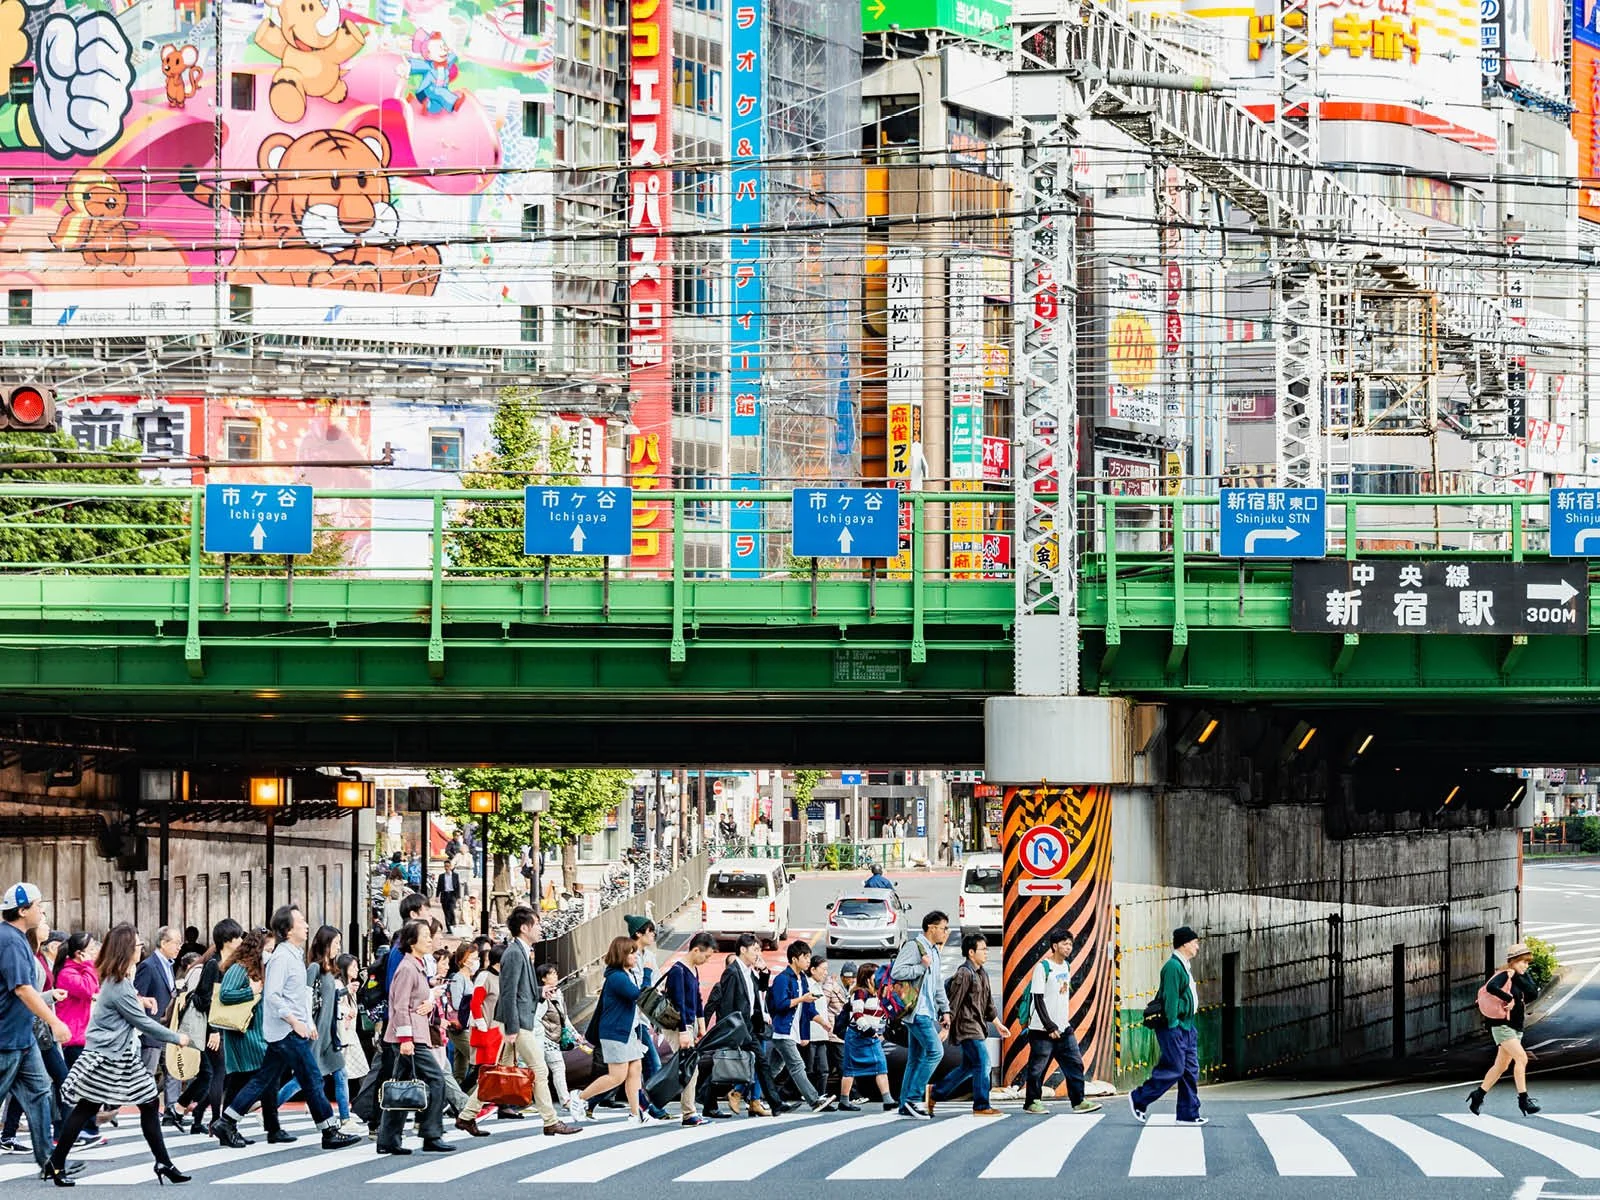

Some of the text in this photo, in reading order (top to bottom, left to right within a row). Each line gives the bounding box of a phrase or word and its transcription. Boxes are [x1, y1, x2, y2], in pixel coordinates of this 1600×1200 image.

[891, 273, 910, 379] 小松ビル
[55, 406, 186, 456] 前店
[891, 406, 909, 474] 麻雀ブル
[630, 432, 661, 556] パチンコ
[1227, 491, 1318, 511] 新宿駅 東口
[1557, 491, 1600, 510] 新宿
[230, 508, 288, 523] Ichigaya
[550, 511, 607, 525] Ichigaya
[817, 513, 874, 526] Ichigaya
[1235, 512, 1310, 526] Shinjuku STN
[1352, 563, 1471, 588] 中央線
[1326, 589, 1496, 627] 新宿駅
[1526, 607, 1577, 624] 300M
